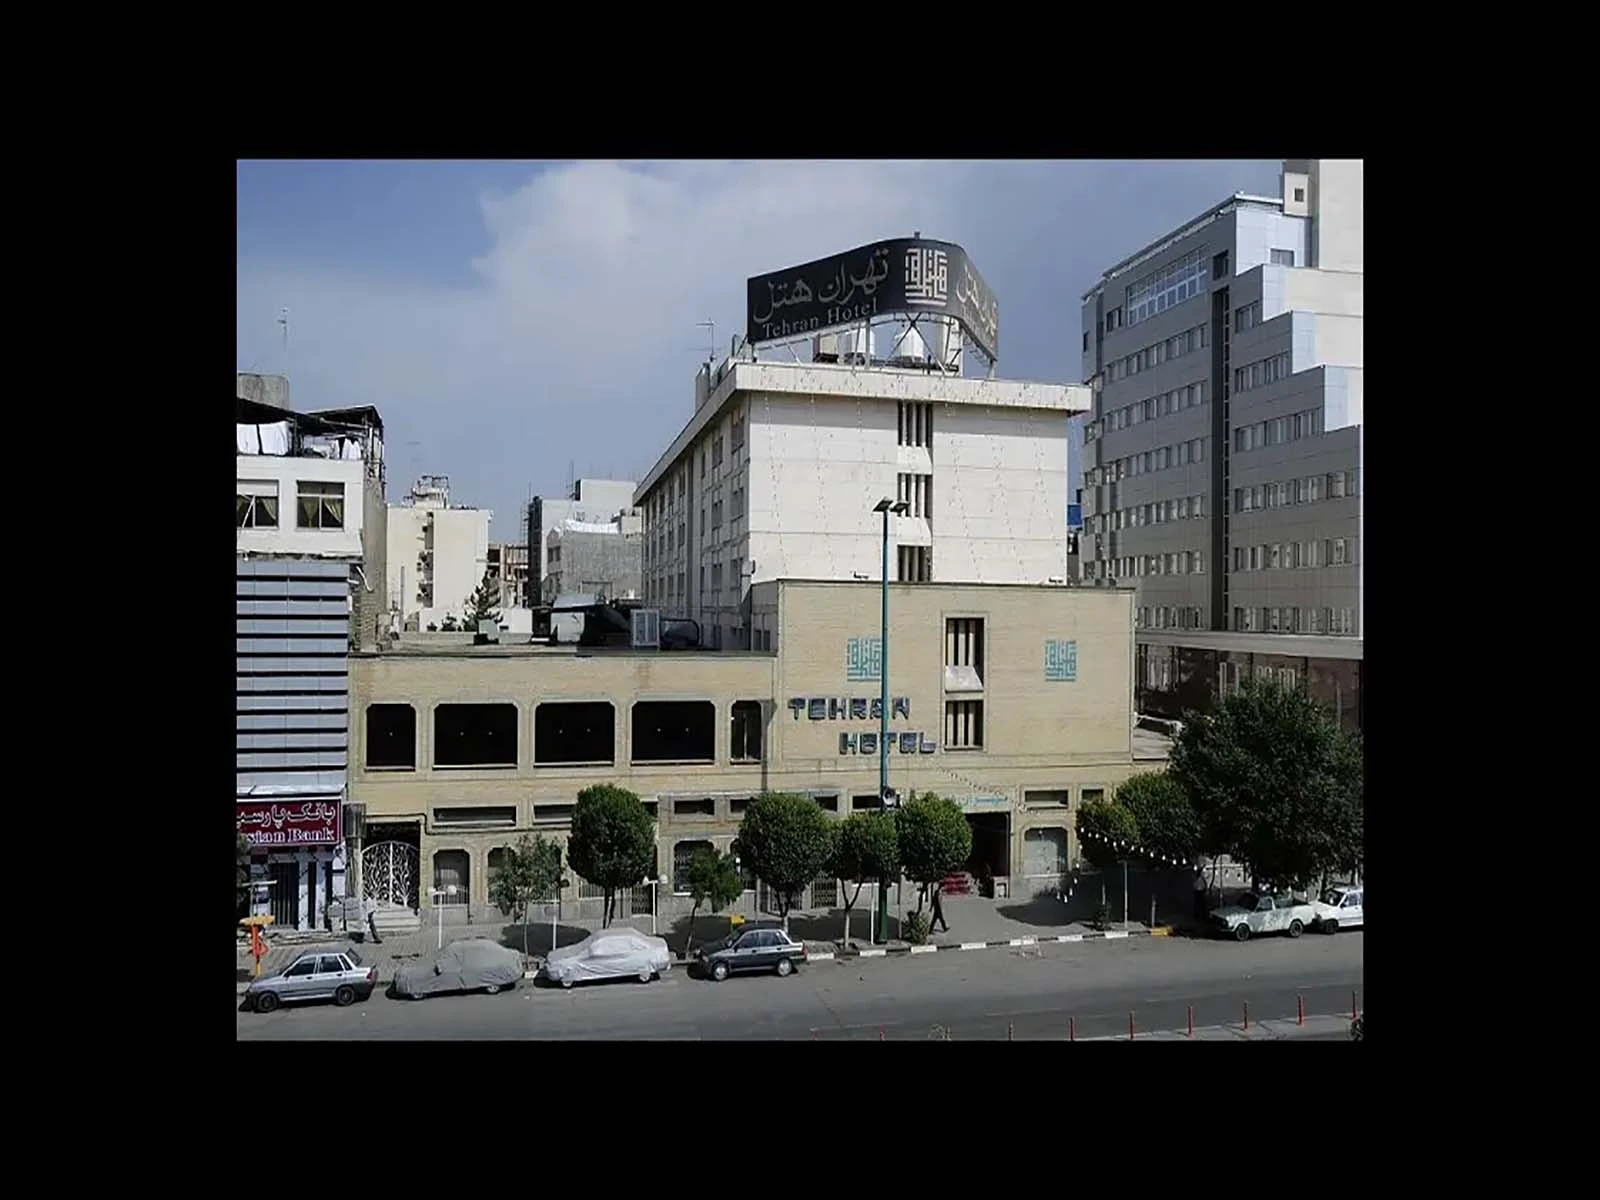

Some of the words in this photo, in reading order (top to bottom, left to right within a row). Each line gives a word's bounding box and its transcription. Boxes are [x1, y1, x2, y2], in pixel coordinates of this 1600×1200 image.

[818, 247, 889, 305] تهران
[753, 279, 813, 323] هتل
[762, 316, 819, 338] Tehran
[827, 296, 877, 325] Hotel
[787, 697, 910, 720] TEHRAN
[838, 732, 937, 755] HOTEL
[236, 804, 287, 829] پارسی
[287, 802, 336, 826] بانک
[287, 827, 335, 842] Bank
